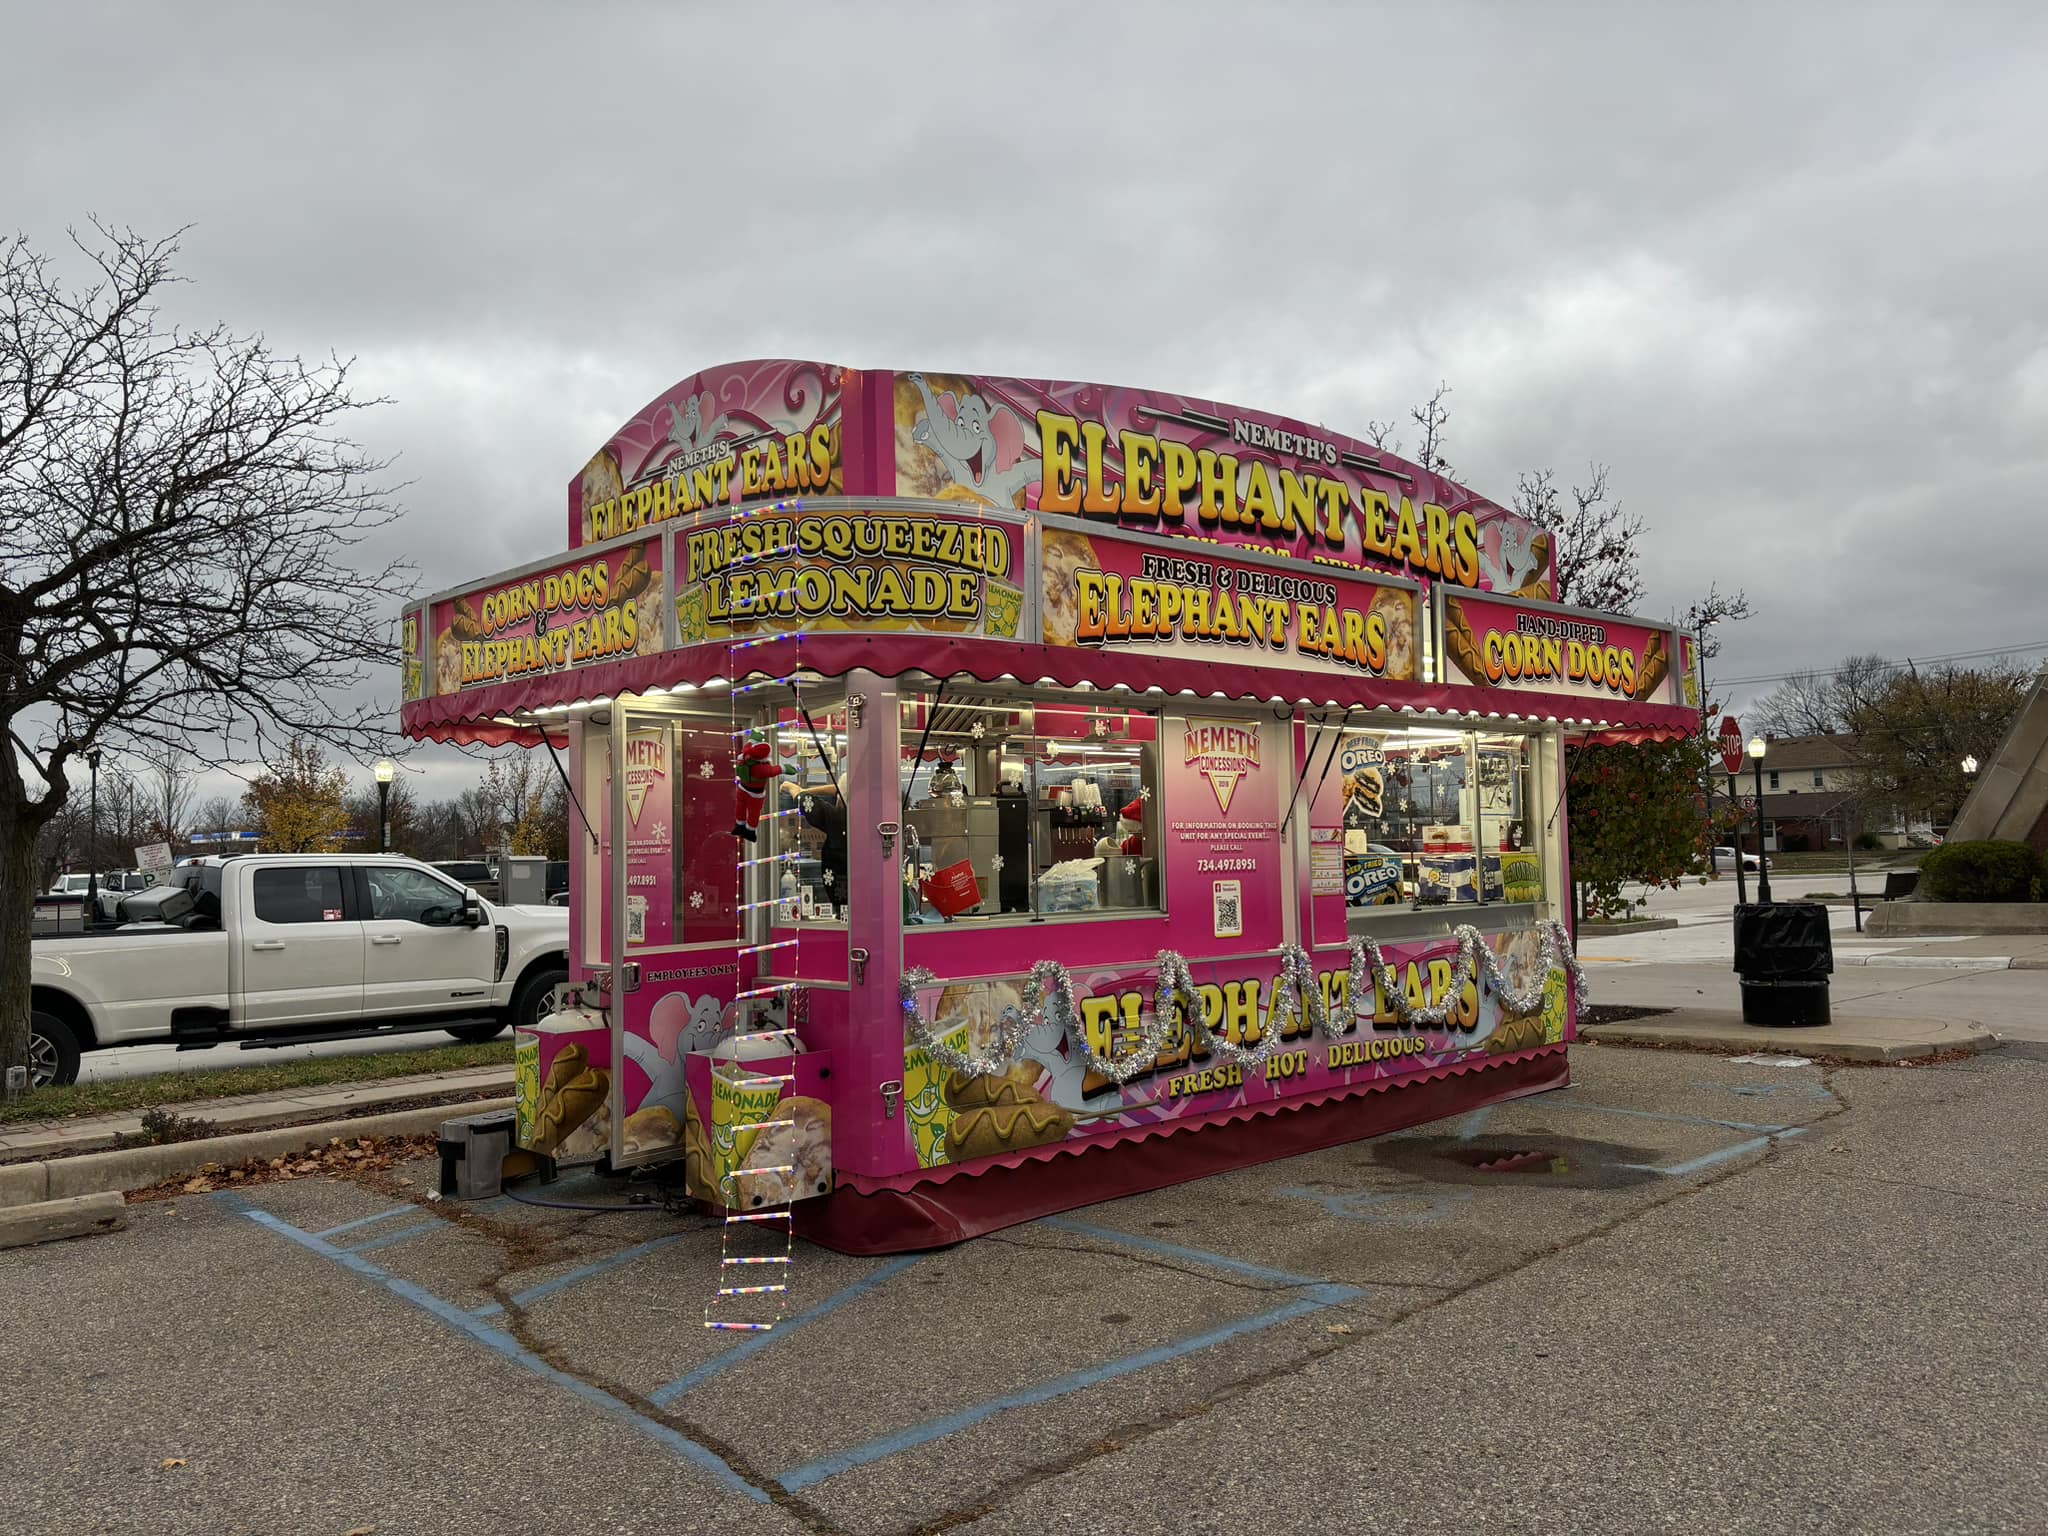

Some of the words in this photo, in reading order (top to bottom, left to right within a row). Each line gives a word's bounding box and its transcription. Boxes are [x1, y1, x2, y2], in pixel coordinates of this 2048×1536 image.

[668, 439, 730, 477] NEMETH'S
[1233, 418, 1338, 465] NEMETH'S
[590, 456, 734, 544] ELEPHANT
[741, 423, 832, 498] EARS
[1036, 408, 1351, 545] ELEPHANT
[1361, 487, 1480, 588] EARS
[686, 522, 793, 585] FRESH
[798, 518, 1011, 579] SQUEEZED
[706, 566, 983, 622] LEMONADE
[1142, 554, 1212, 586] FRESH
[1215, 565, 1233, 590] &
[1236, 570, 1336, 604] DELICIOUS
[481, 578, 541, 639] CORN
[543, 560, 610, 611] DOGS
[535, 608, 549, 637] &
[1074, 567, 1291, 651] ELEPHANT
[1297, 601, 1388, 677] EARS
[1516, 613, 1605, 644] HAND-DIPPED
[461, 625, 570, 687] ELEPHANT
[572, 598, 640, 665] EARS
[1482, 629, 1563, 686] CORN
[1567, 640, 1637, 700] DOGS
[1186, 727, 1260, 763] NEMETH
[1200, 756, 1247, 772] CONCESSIONS
[1341, 750, 1383, 770] OREO
[1172, 822, 1184, 830] FOR
[1185, 822, 1227, 830] INFORMATION
[1228, 822, 1237, 830] ON
[1238, 822, 1264, 830] BOOKING
[1265, 822, 1278, 830] THIS
[1180, 832, 1195, 840] UNIT
[1197, 832, 1208, 840] FOR
[1210, 832, 1223, 840] ANY
[1224, 832, 1247, 840] SPECIAL
[1197, 859, 1256, 871] 734.497.8951
[1346, 866, 1398, 895] OREO
[647, 967, 709, 983] EMPLOYEES
[710, 963, 738, 976] ONLY
[1169, 1064, 1243, 1098] FRESH
[1266, 1049, 1309, 1081] HOT
[1328, 1035, 1426, 1070] DELICIOUS
[715, 1083, 778, 1110] LEMONADE
